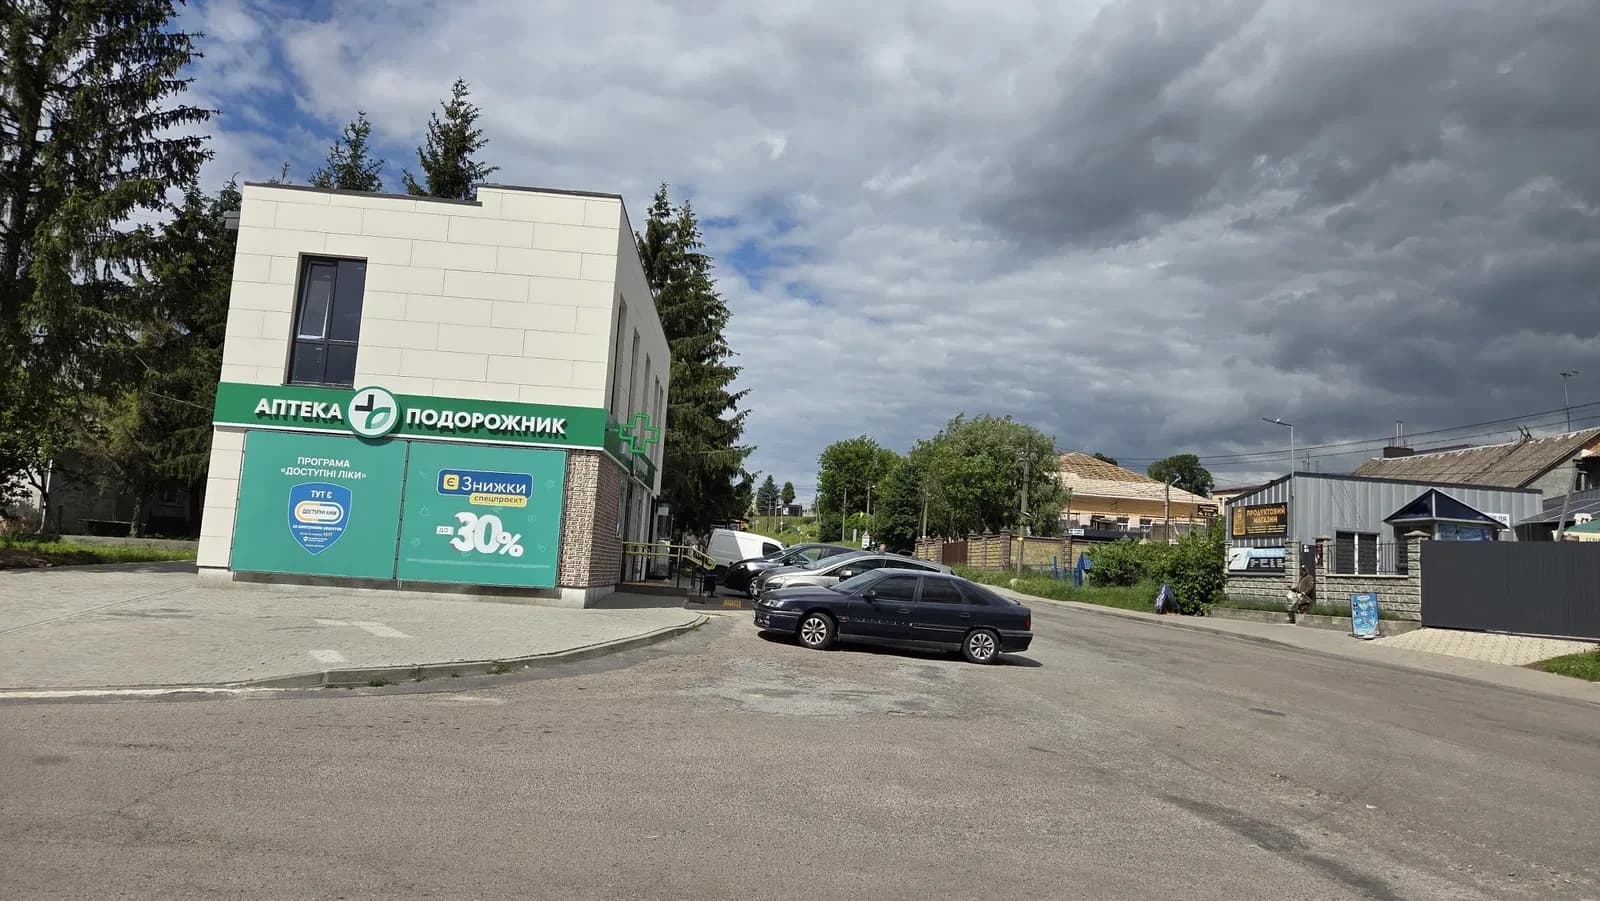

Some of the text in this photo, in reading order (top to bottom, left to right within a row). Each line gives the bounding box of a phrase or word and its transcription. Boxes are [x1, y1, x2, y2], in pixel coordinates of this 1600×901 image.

[254, 398, 567, 434] АПТЕКА ПОДОРОЖНИК
[297, 456, 350, 468] ПРОГРАМА
[461, 476, 526, 494] Знижки
[311, 490, 326, 499] ТУТ
[474, 495, 523, 504] спецпроєкт
[1246, 505, 1286, 517] ПРОДУКТОВИЙ
[1253, 516, 1278, 524] МАГАЗИН
